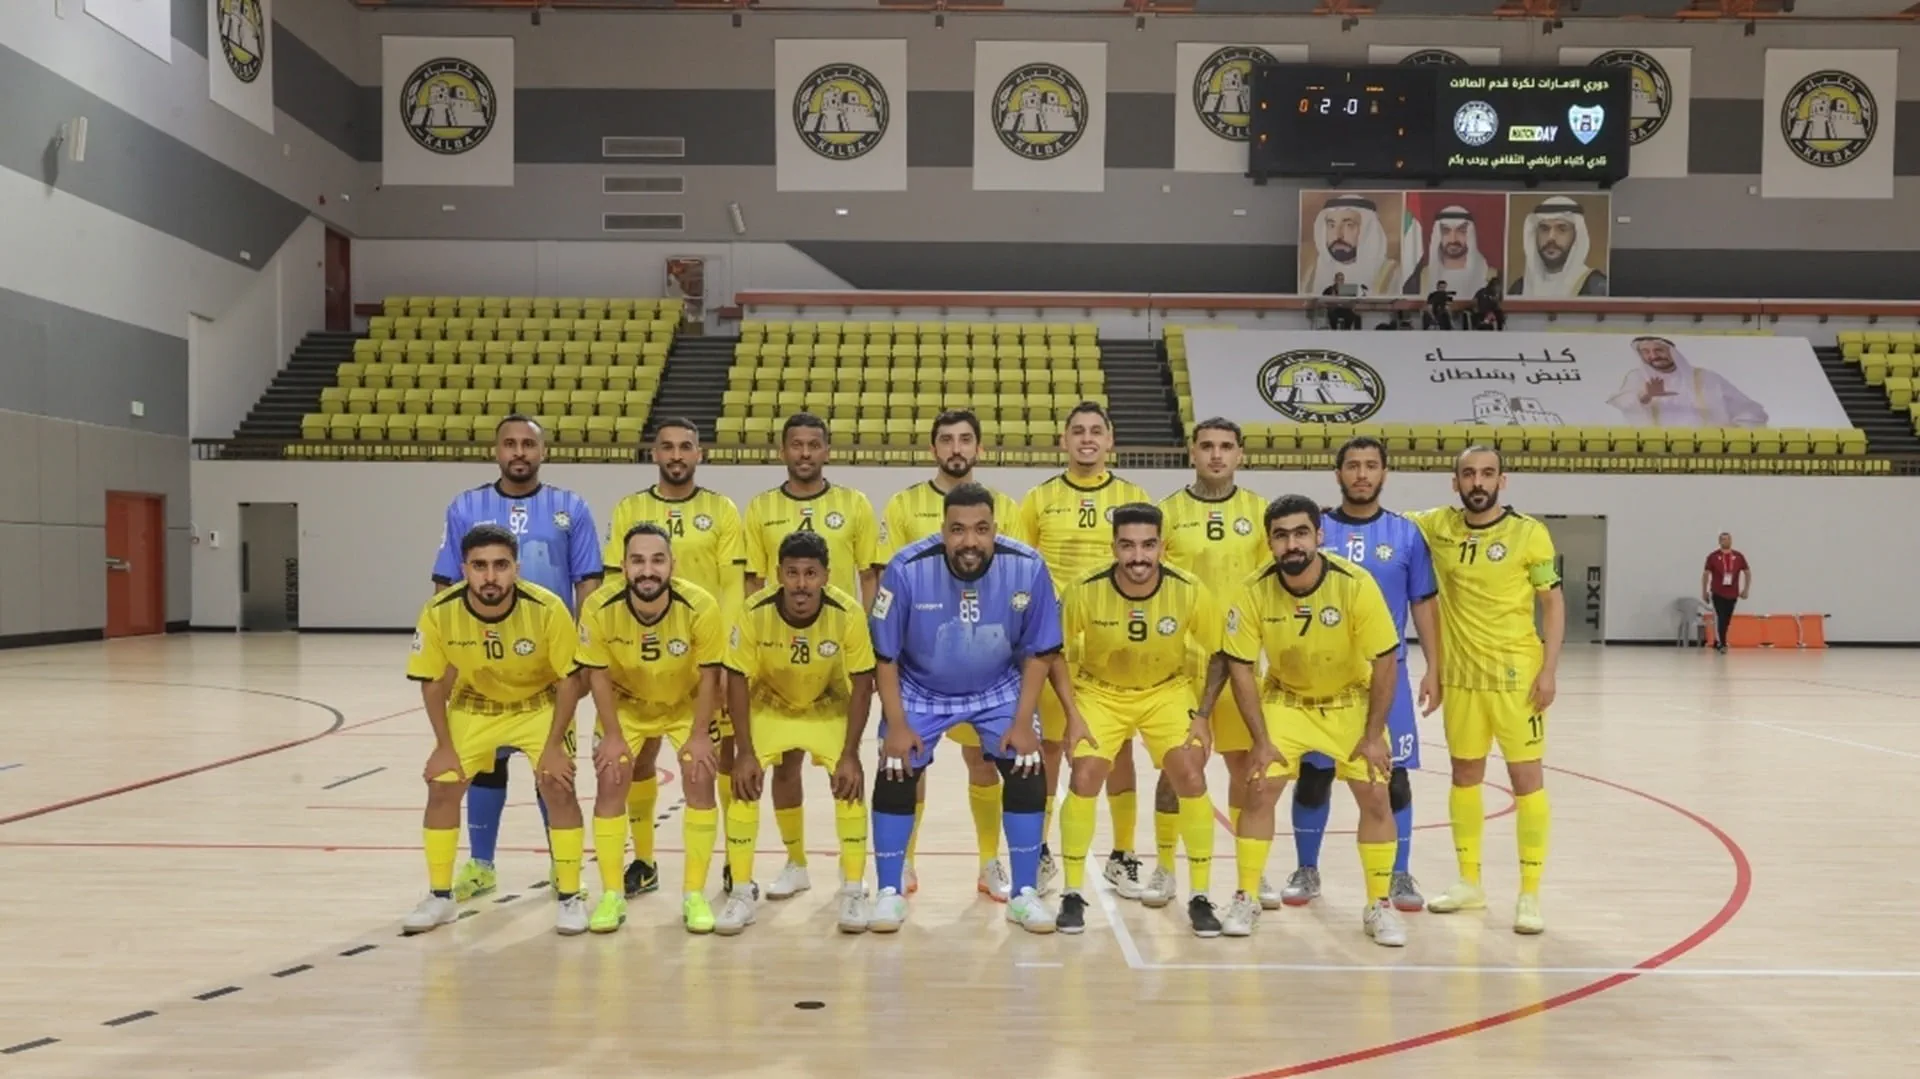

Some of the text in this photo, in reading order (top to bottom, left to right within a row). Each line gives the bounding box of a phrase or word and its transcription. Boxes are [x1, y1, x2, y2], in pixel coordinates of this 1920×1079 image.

[1488, 78, 1509, 91] قدم
[1512, 77, 1535, 91] لكرة
[424, 134, 473, 150] KALBA
[818, 141, 867, 156] KALBA
[1015, 141, 1064, 155] KALBA
[1803, 148, 1852, 163] KALBA
[509, 513, 529, 534] 92
[666, 518, 684, 538] 14
[796, 517, 815, 533] 4
[1078, 508, 1096, 528] 20
[1206, 520, 1225, 541] 6
[1345, 541, 1365, 562] 13
[1458, 541, 1477, 565] 11
[1586, 566, 1600, 630] EXIT
[959, 600, 980, 623] 85
[1128, 620, 1148, 642] 9
[1294, 614, 1313, 637] 7
[483, 640, 504, 660] 10
[641, 641, 661, 661] 5
[790, 644, 810, 664] 28
[1528, 715, 1544, 738] 11
[1398, 733, 1414, 757] 13
